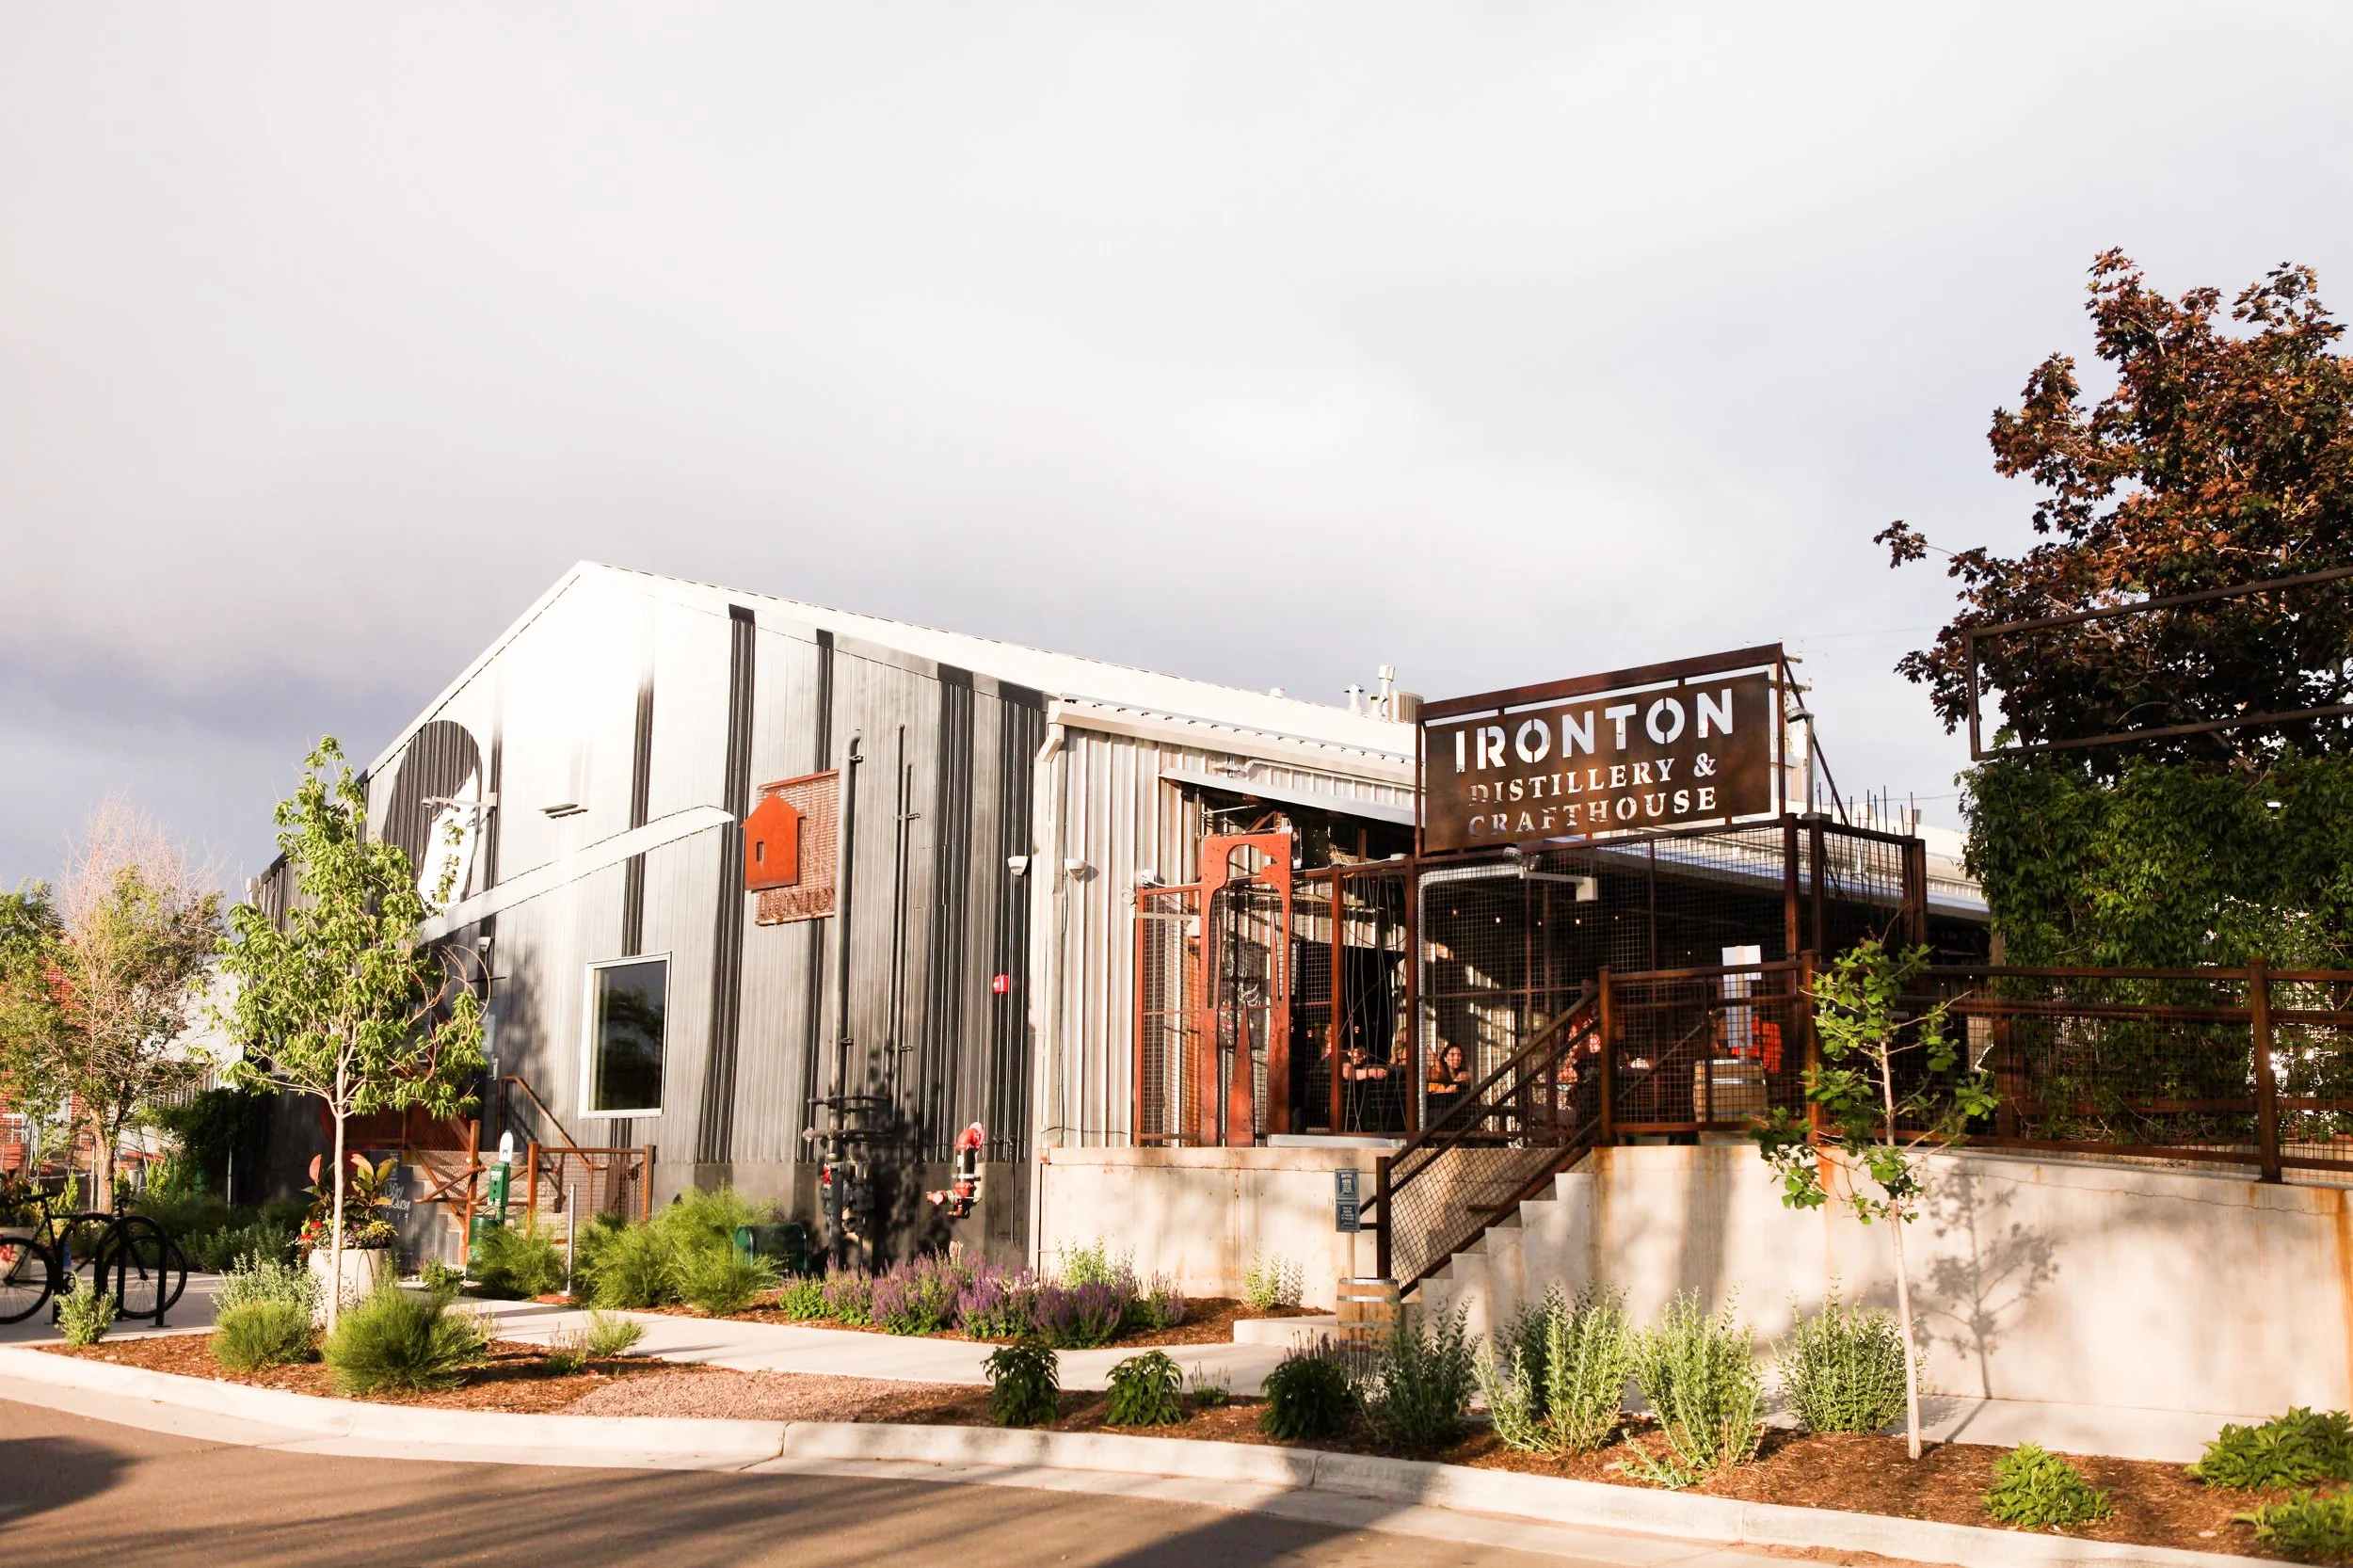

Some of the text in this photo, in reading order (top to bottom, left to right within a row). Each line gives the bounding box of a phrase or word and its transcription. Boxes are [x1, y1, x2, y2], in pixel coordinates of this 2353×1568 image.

[1455, 688, 1734, 774] IRONTON
[1468, 752, 1717, 807] DISTILLERY &
[1467, 786, 1717, 838] CRAFTHOUSE
